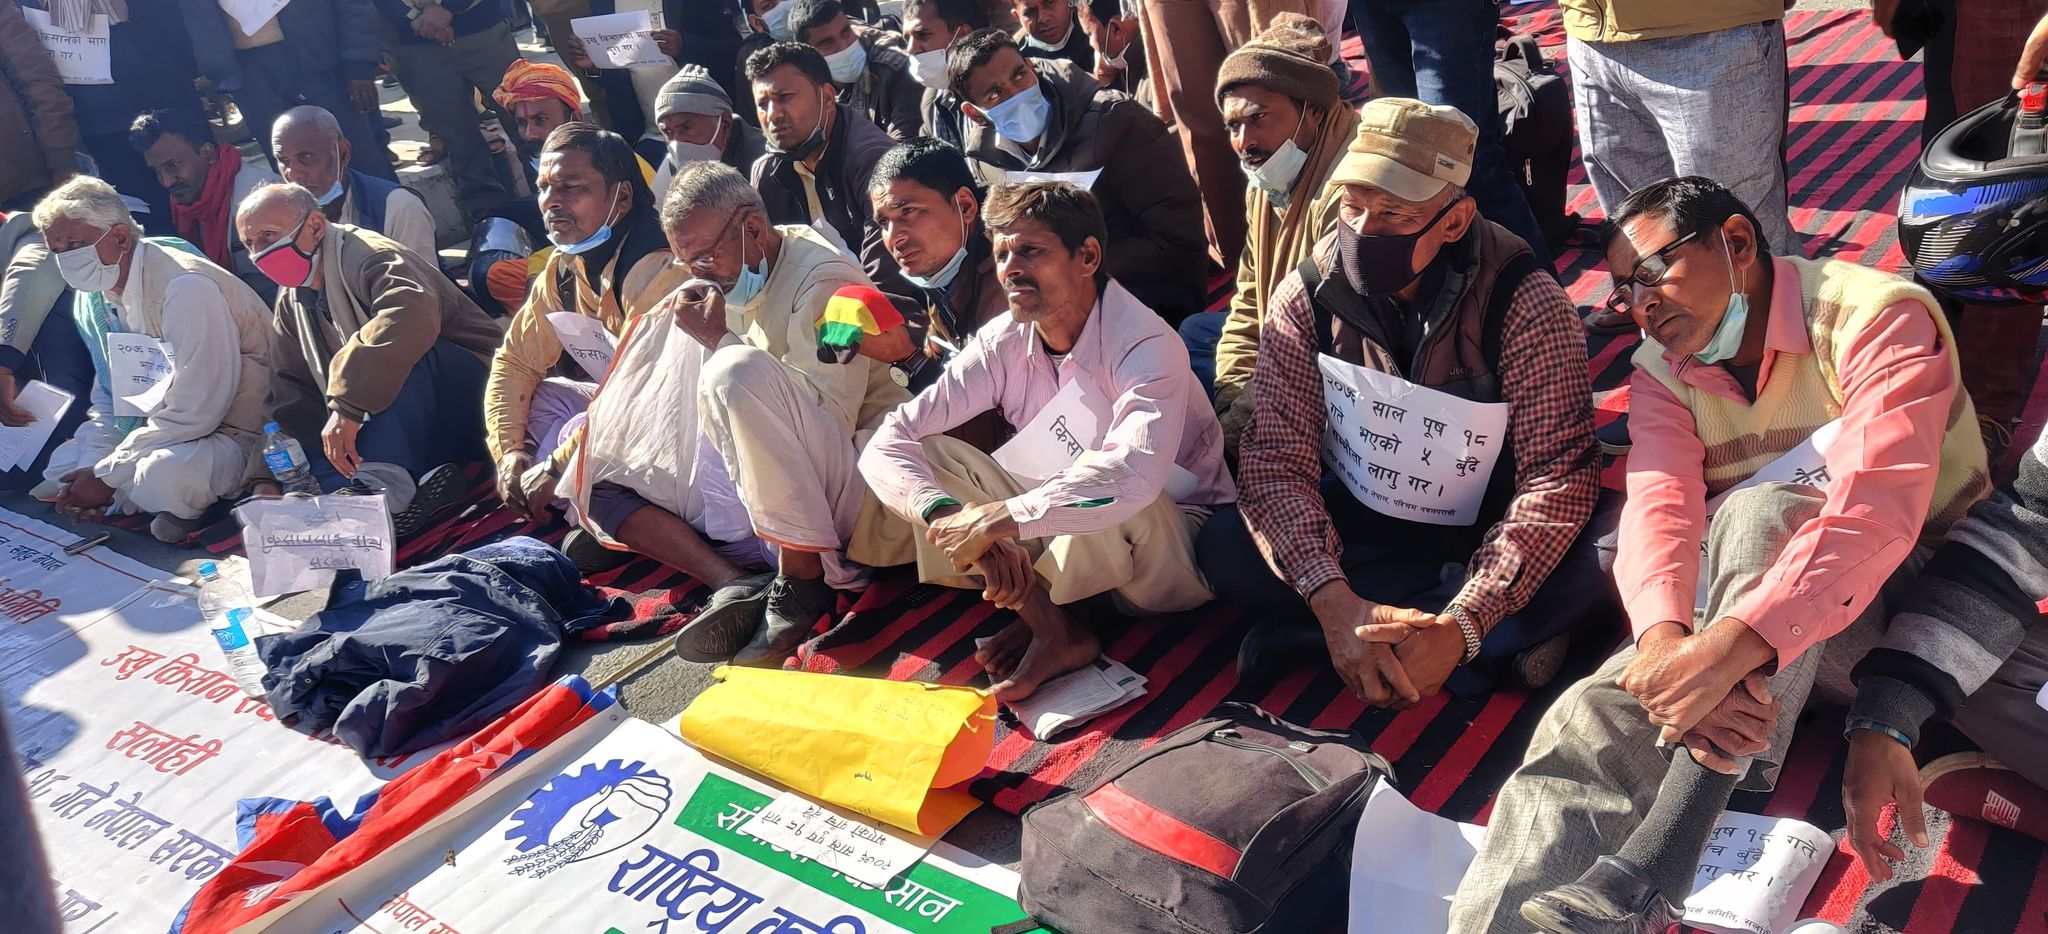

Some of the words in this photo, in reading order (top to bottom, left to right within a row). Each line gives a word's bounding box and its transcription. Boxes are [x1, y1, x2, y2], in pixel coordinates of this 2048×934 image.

[1330, 402, 1345, 426] गते
[1359, 425, 1402, 455] भएको
[1372, 400, 1408, 424] साल
[1423, 416, 1448, 440] पूष
[1463, 429, 1488, 448] १८
[1368, 461, 1401, 490] लागु
[1408, 474, 1433, 495] गर
[143, 652, 241, 705] किसान
[49, 781, 120, 820] गते
[84, 791, 175, 851] नेपाल
[1787, 835, 1819, 860] गते
